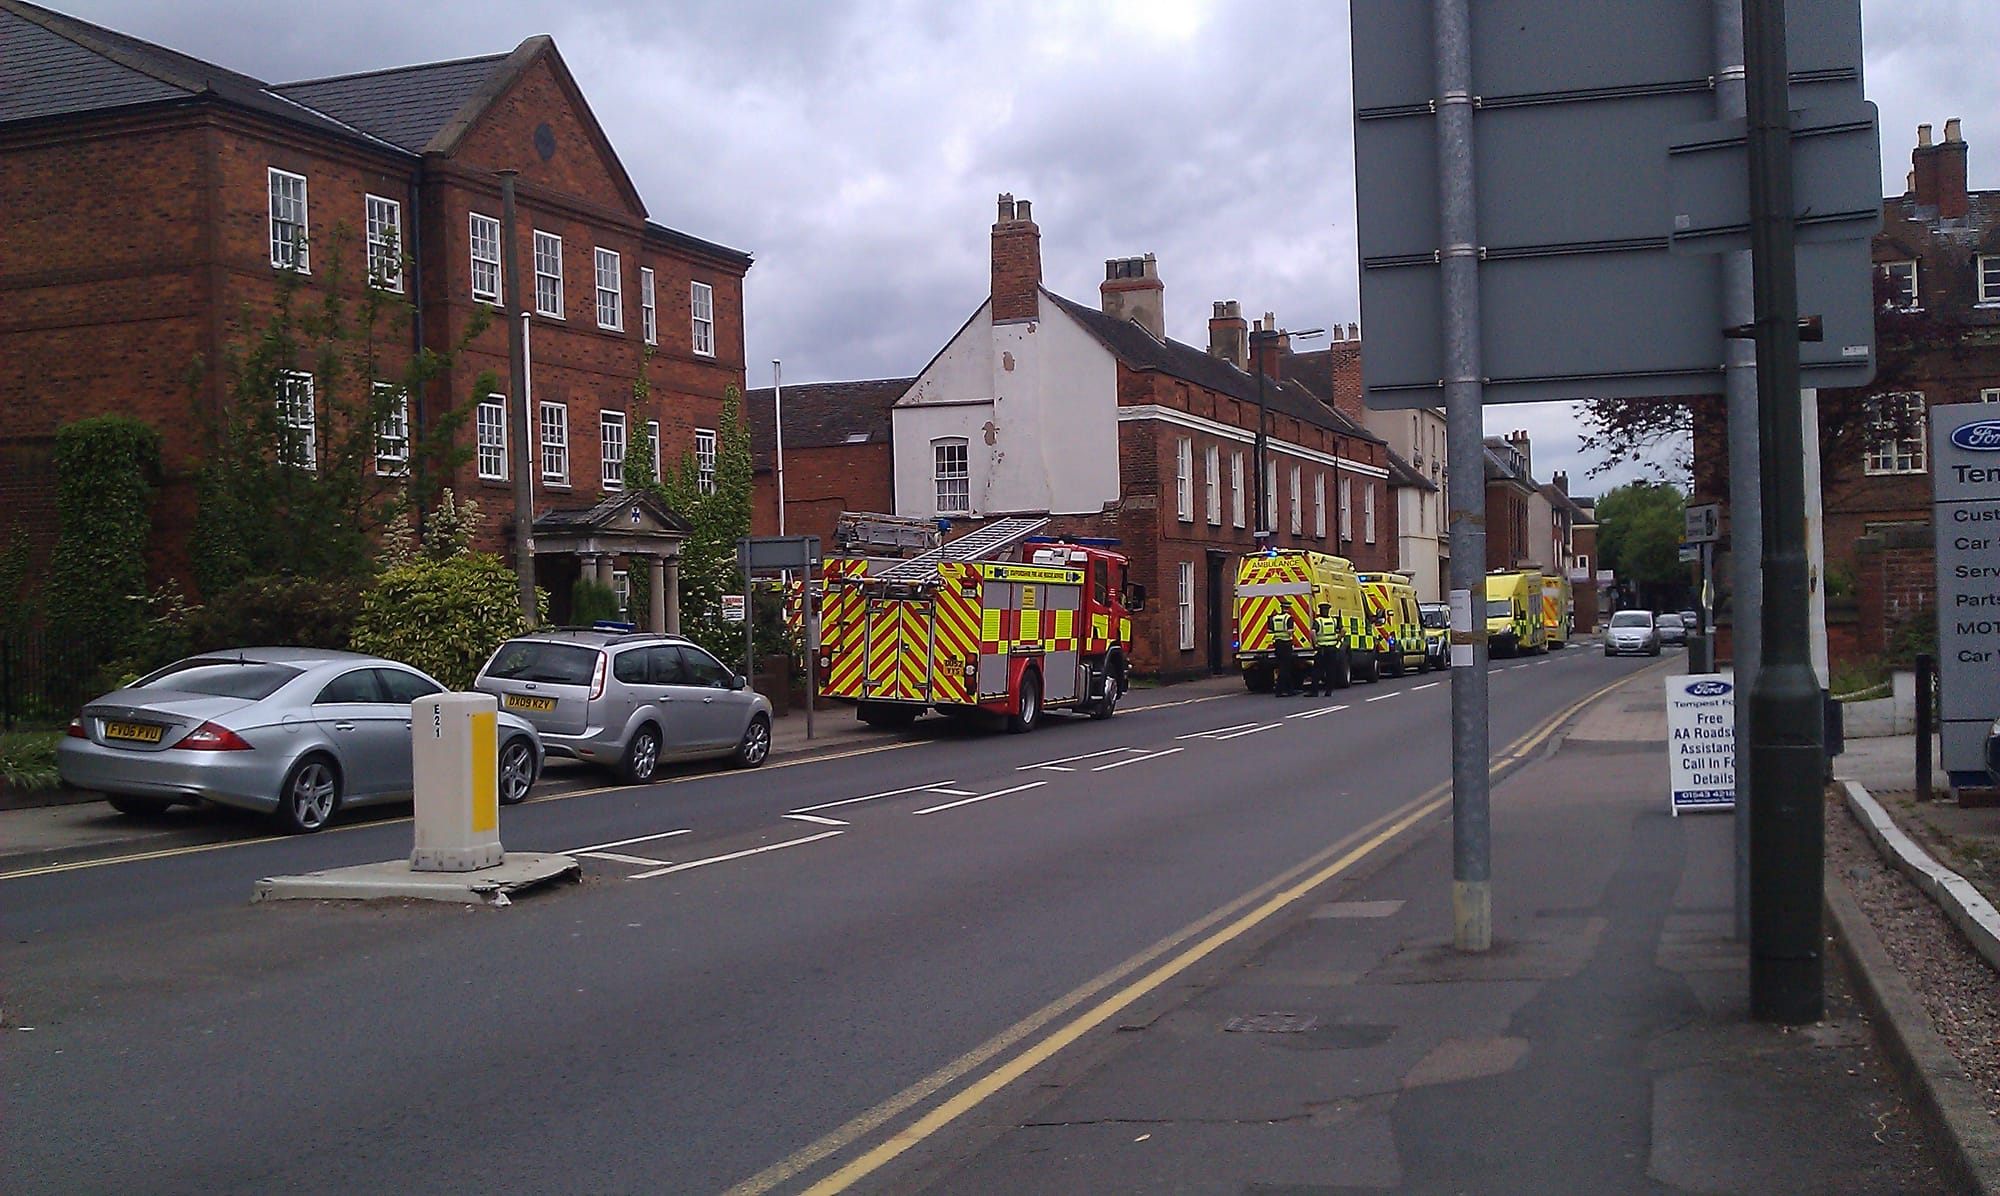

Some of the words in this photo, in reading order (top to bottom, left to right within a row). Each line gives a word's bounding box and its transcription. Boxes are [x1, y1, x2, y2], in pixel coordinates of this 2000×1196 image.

[1954, 537, 1990, 550] Car
[1251, 559, 1300, 568] AMBULANCE
[1955, 565, 2000, 578] Serv
[1957, 621, 2000, 635] MOT
[1958, 650, 1992, 663] Car
[509, 696, 531, 707] DX09
[1674, 700, 1719, 708] Tempest
[1697, 713, 1723, 724] Free
[1674, 728, 1690, 739] AA
[1683, 757, 1705, 769] Call
[1709, 757, 1720, 768] In
[1693, 773, 1734, 784] Details
